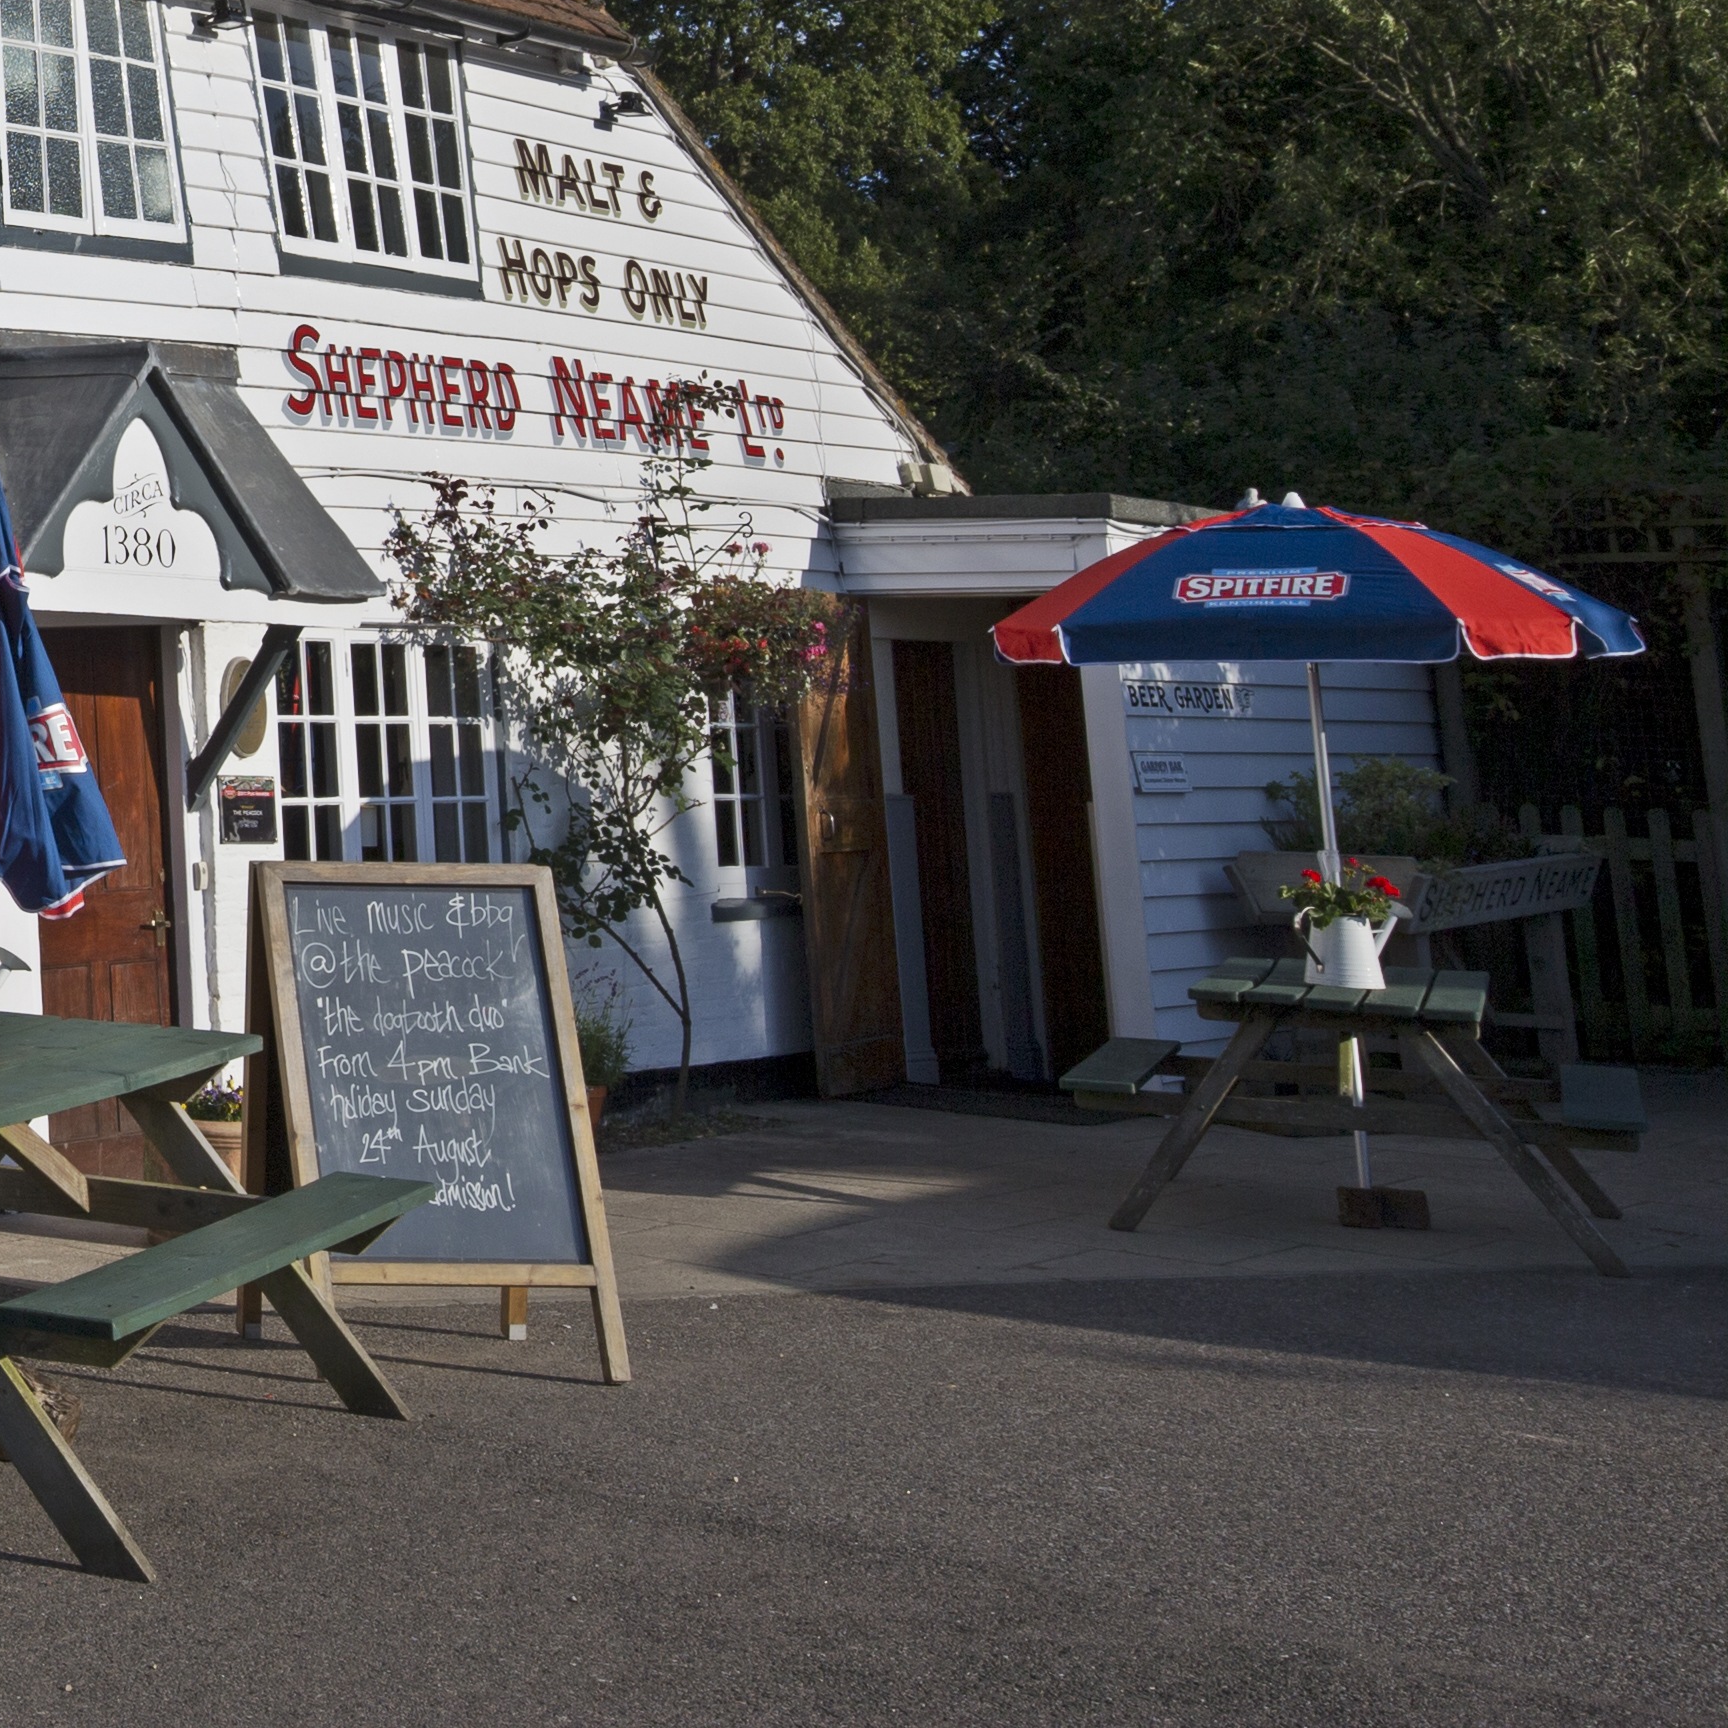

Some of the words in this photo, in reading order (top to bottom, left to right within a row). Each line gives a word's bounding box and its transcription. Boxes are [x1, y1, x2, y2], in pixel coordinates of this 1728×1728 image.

[514, 138, 625, 218] MALT
[637, 170, 663, 224] &
[498, 236, 600, 313] HOPS
[623, 259, 708, 329] ONLY
[283, 324, 521, 440] SHEPHERD
[549, 356, 710, 459] NEAME
[113, 479, 164, 514] CIRCA
[102, 524, 176, 568] 1380
[1186, 575, 1334, 598] SPITFIRE
[1127, 685, 1173, 713] BEER
[1174, 686, 1234, 713] GARDEN
[1530, 866, 1595, 903] NEAME
[293, 896, 346, 935] Live
[367, 893, 435, 935] music
[401, 939, 514, 999] peacock
[373, 995, 464, 1050] dogtooth
[317, 1046, 378, 1078] From
[468, 1043, 550, 1078] Bank
[406, 1076, 495, 1140] sunday
[360, 1124, 403, 1165] 24th
